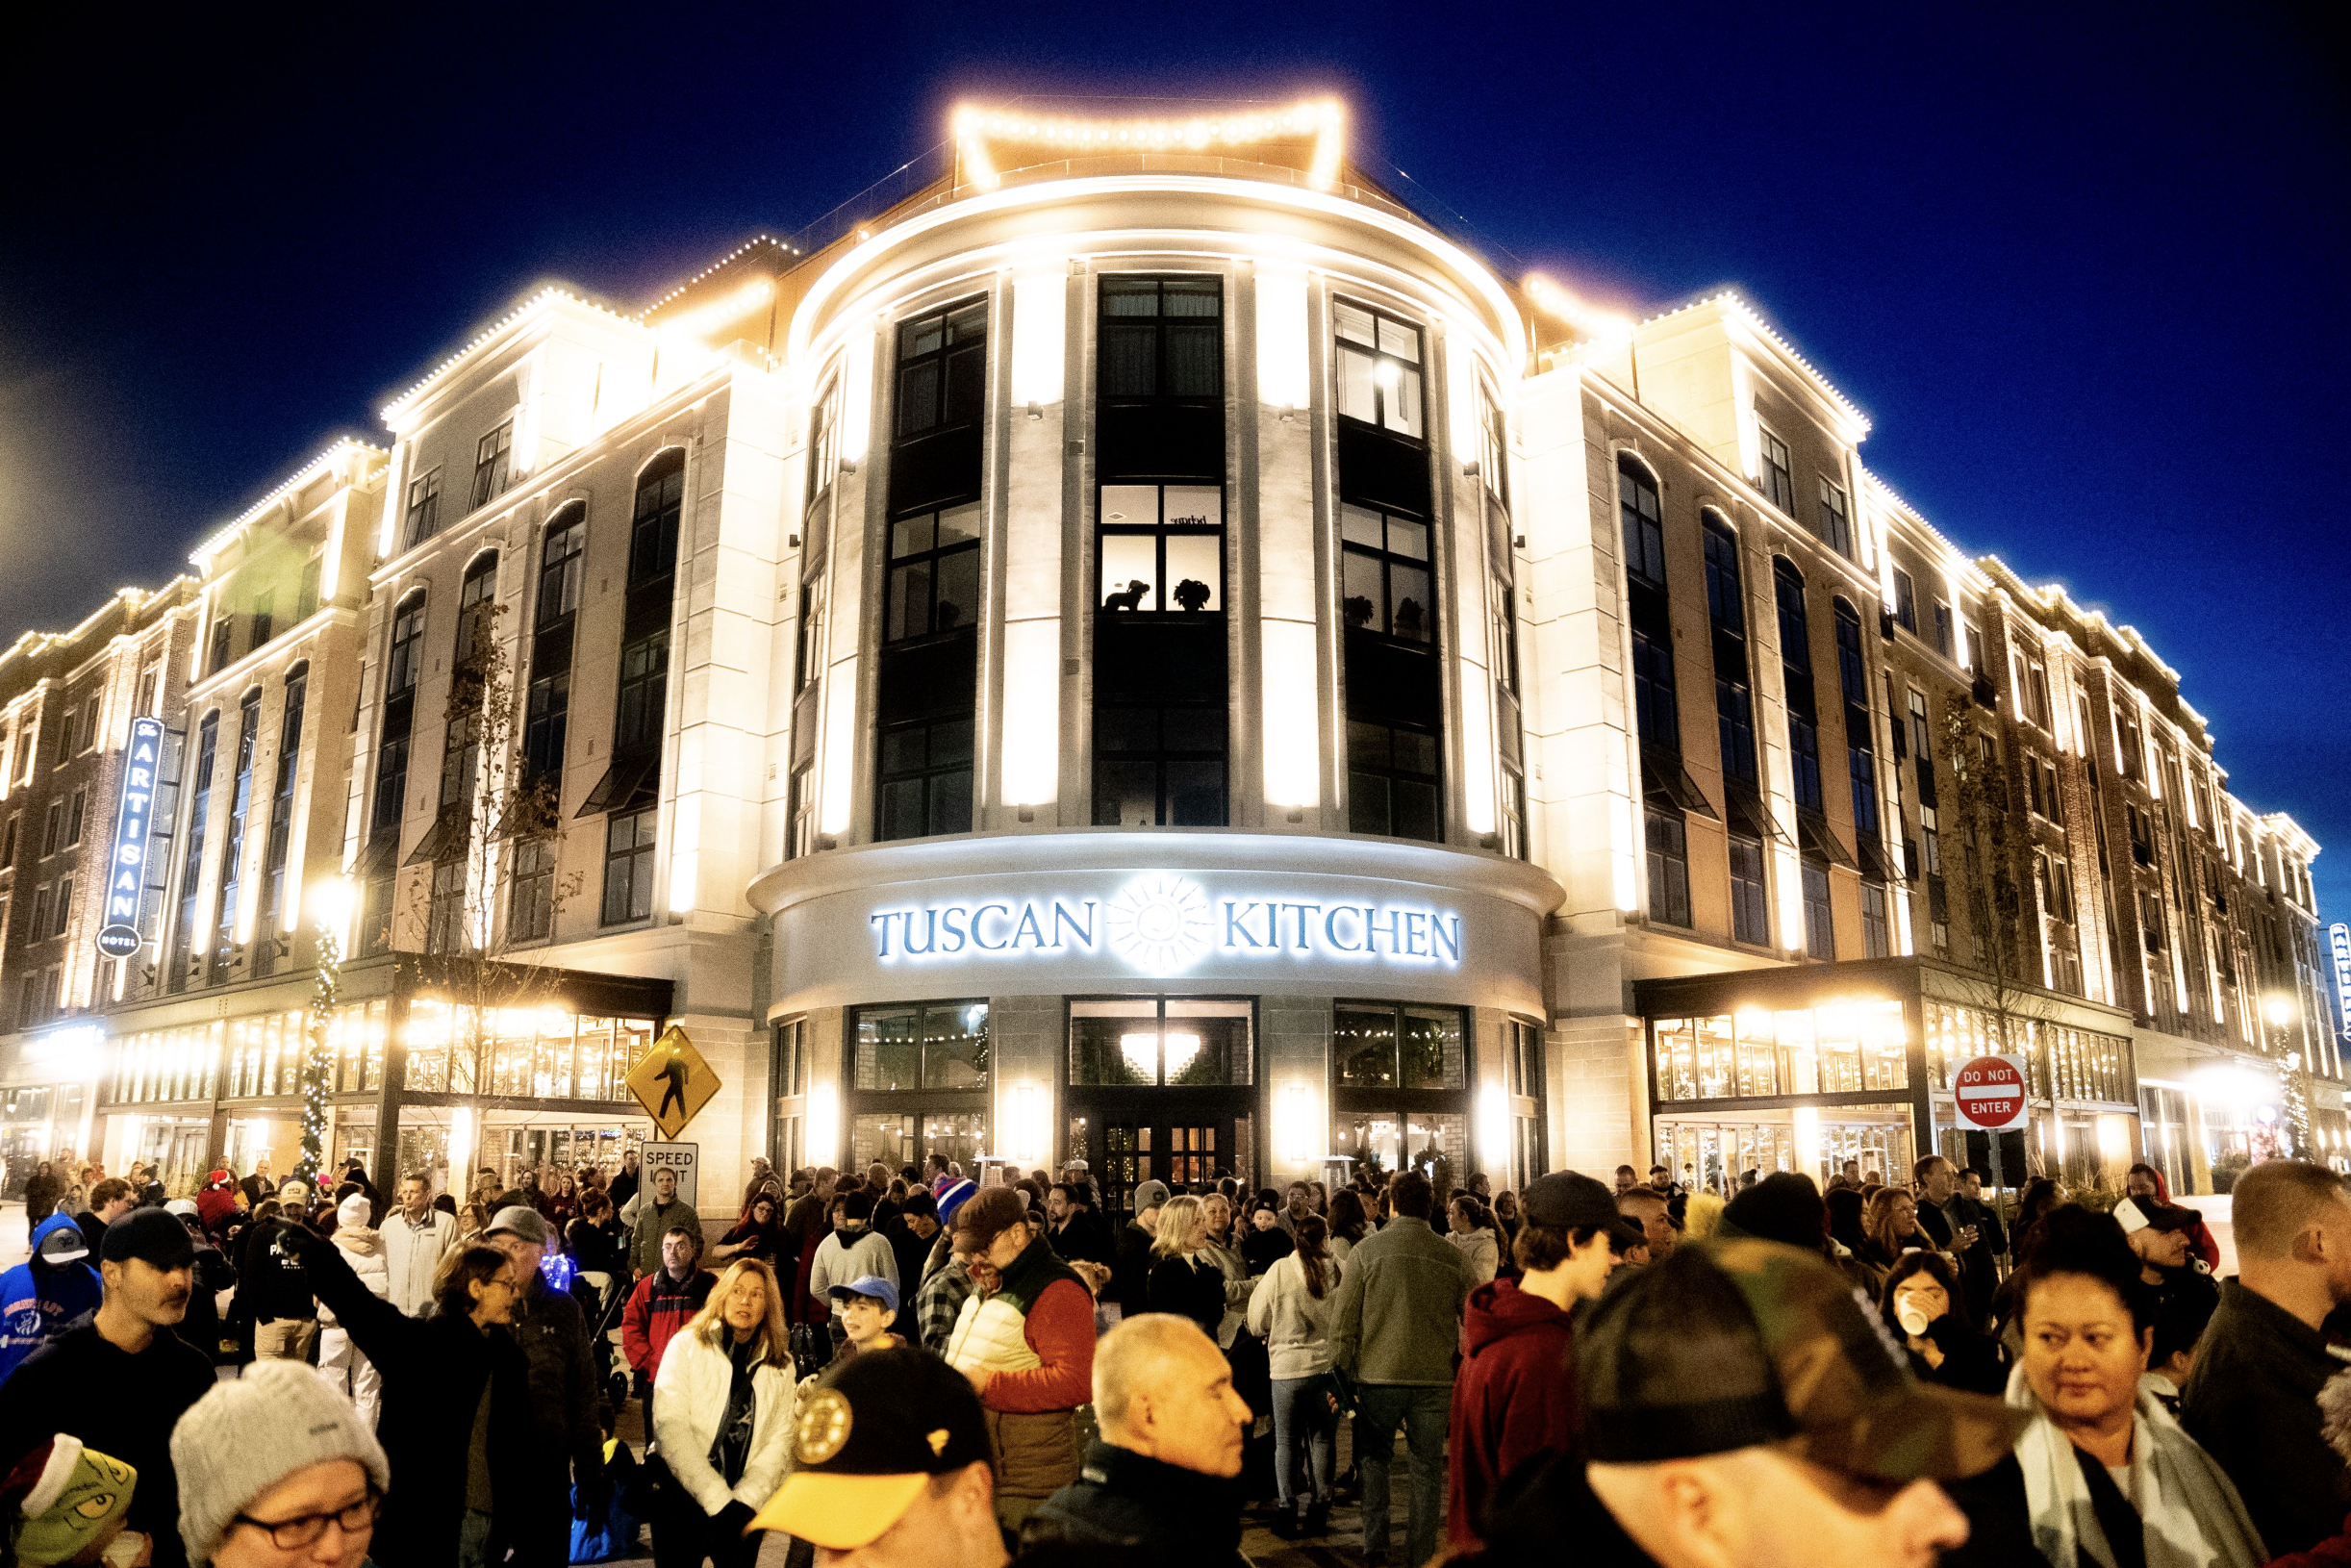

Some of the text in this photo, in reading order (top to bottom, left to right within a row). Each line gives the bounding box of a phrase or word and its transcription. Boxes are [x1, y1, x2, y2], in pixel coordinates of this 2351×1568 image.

[112, 743, 154, 918] ARTISAN
[871, 902, 1459, 961] TUSCAN KITCHEN
[101, 936, 137, 948] HOTEL
[1963, 1069, 2012, 1083] DO NOT
[1970, 1101, 2011, 1114] ENTER
[645, 1151, 693, 1165] SPEED
[649, 1170, 688, 1182] LIT
